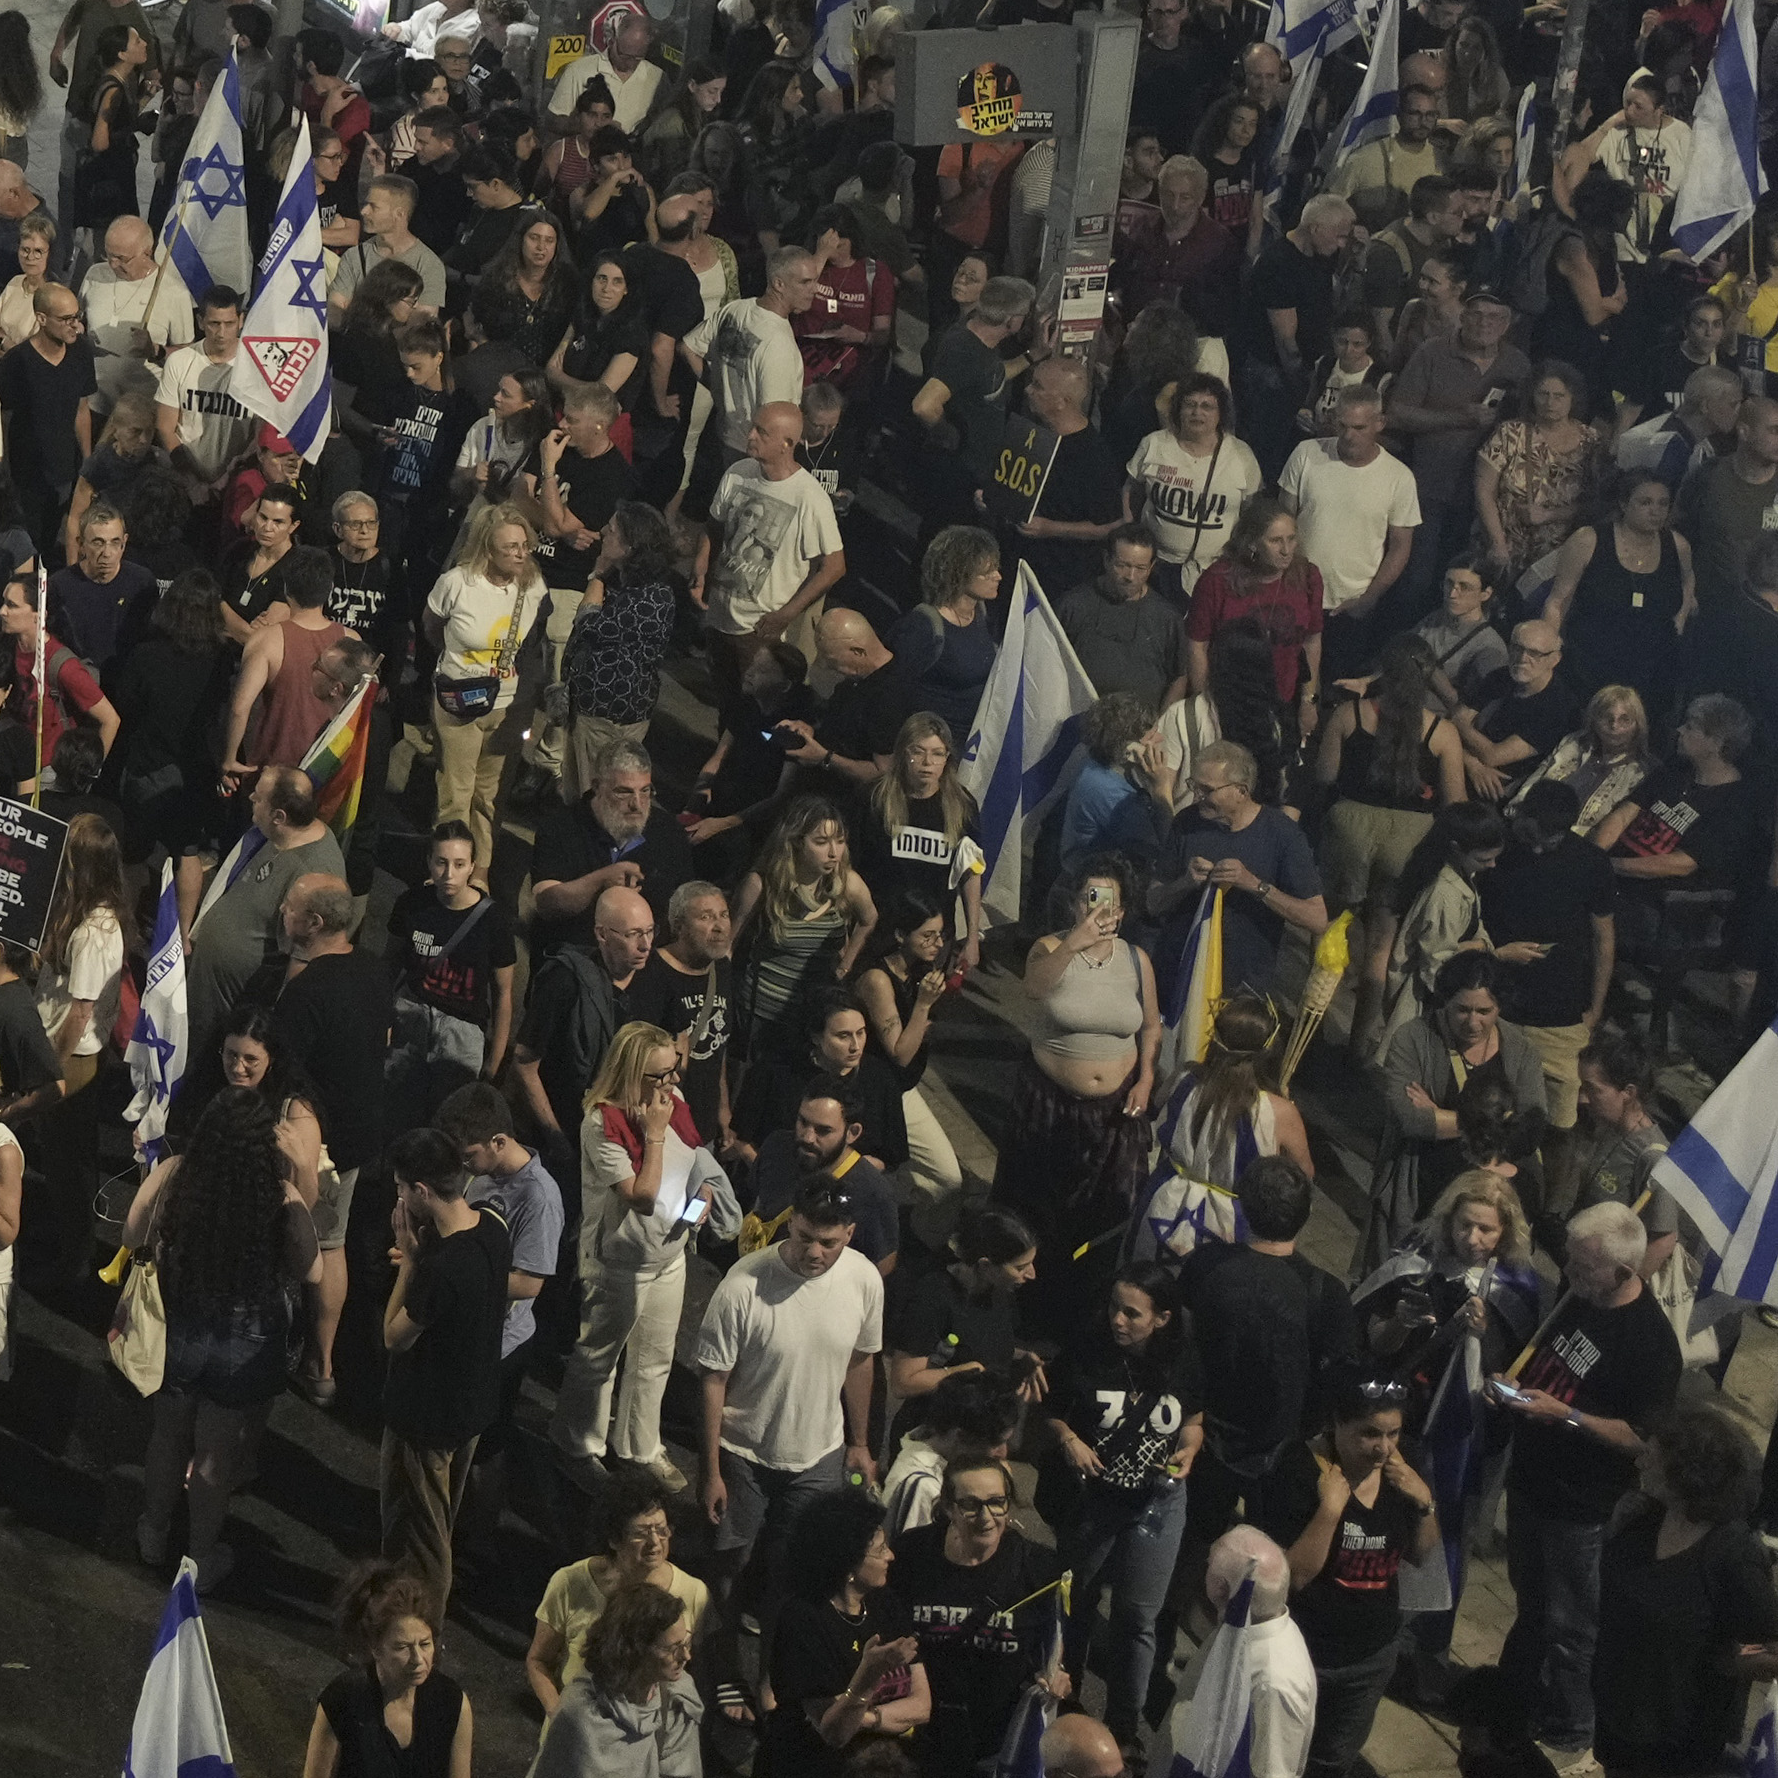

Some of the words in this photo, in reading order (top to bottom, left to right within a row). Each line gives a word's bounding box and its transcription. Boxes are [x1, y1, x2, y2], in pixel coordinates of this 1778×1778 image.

[554, 36, 582, 55] 200
[970, 96, 1013, 115] מחריב
[971, 111, 1016, 130] ישראל
[1066, 264, 1108, 273] KIDNAPPED
[994, 448, 1042, 496] S.O.S
[411, 930, 434, 943] BRING
[1364, 1535, 1386, 1549] HOME
